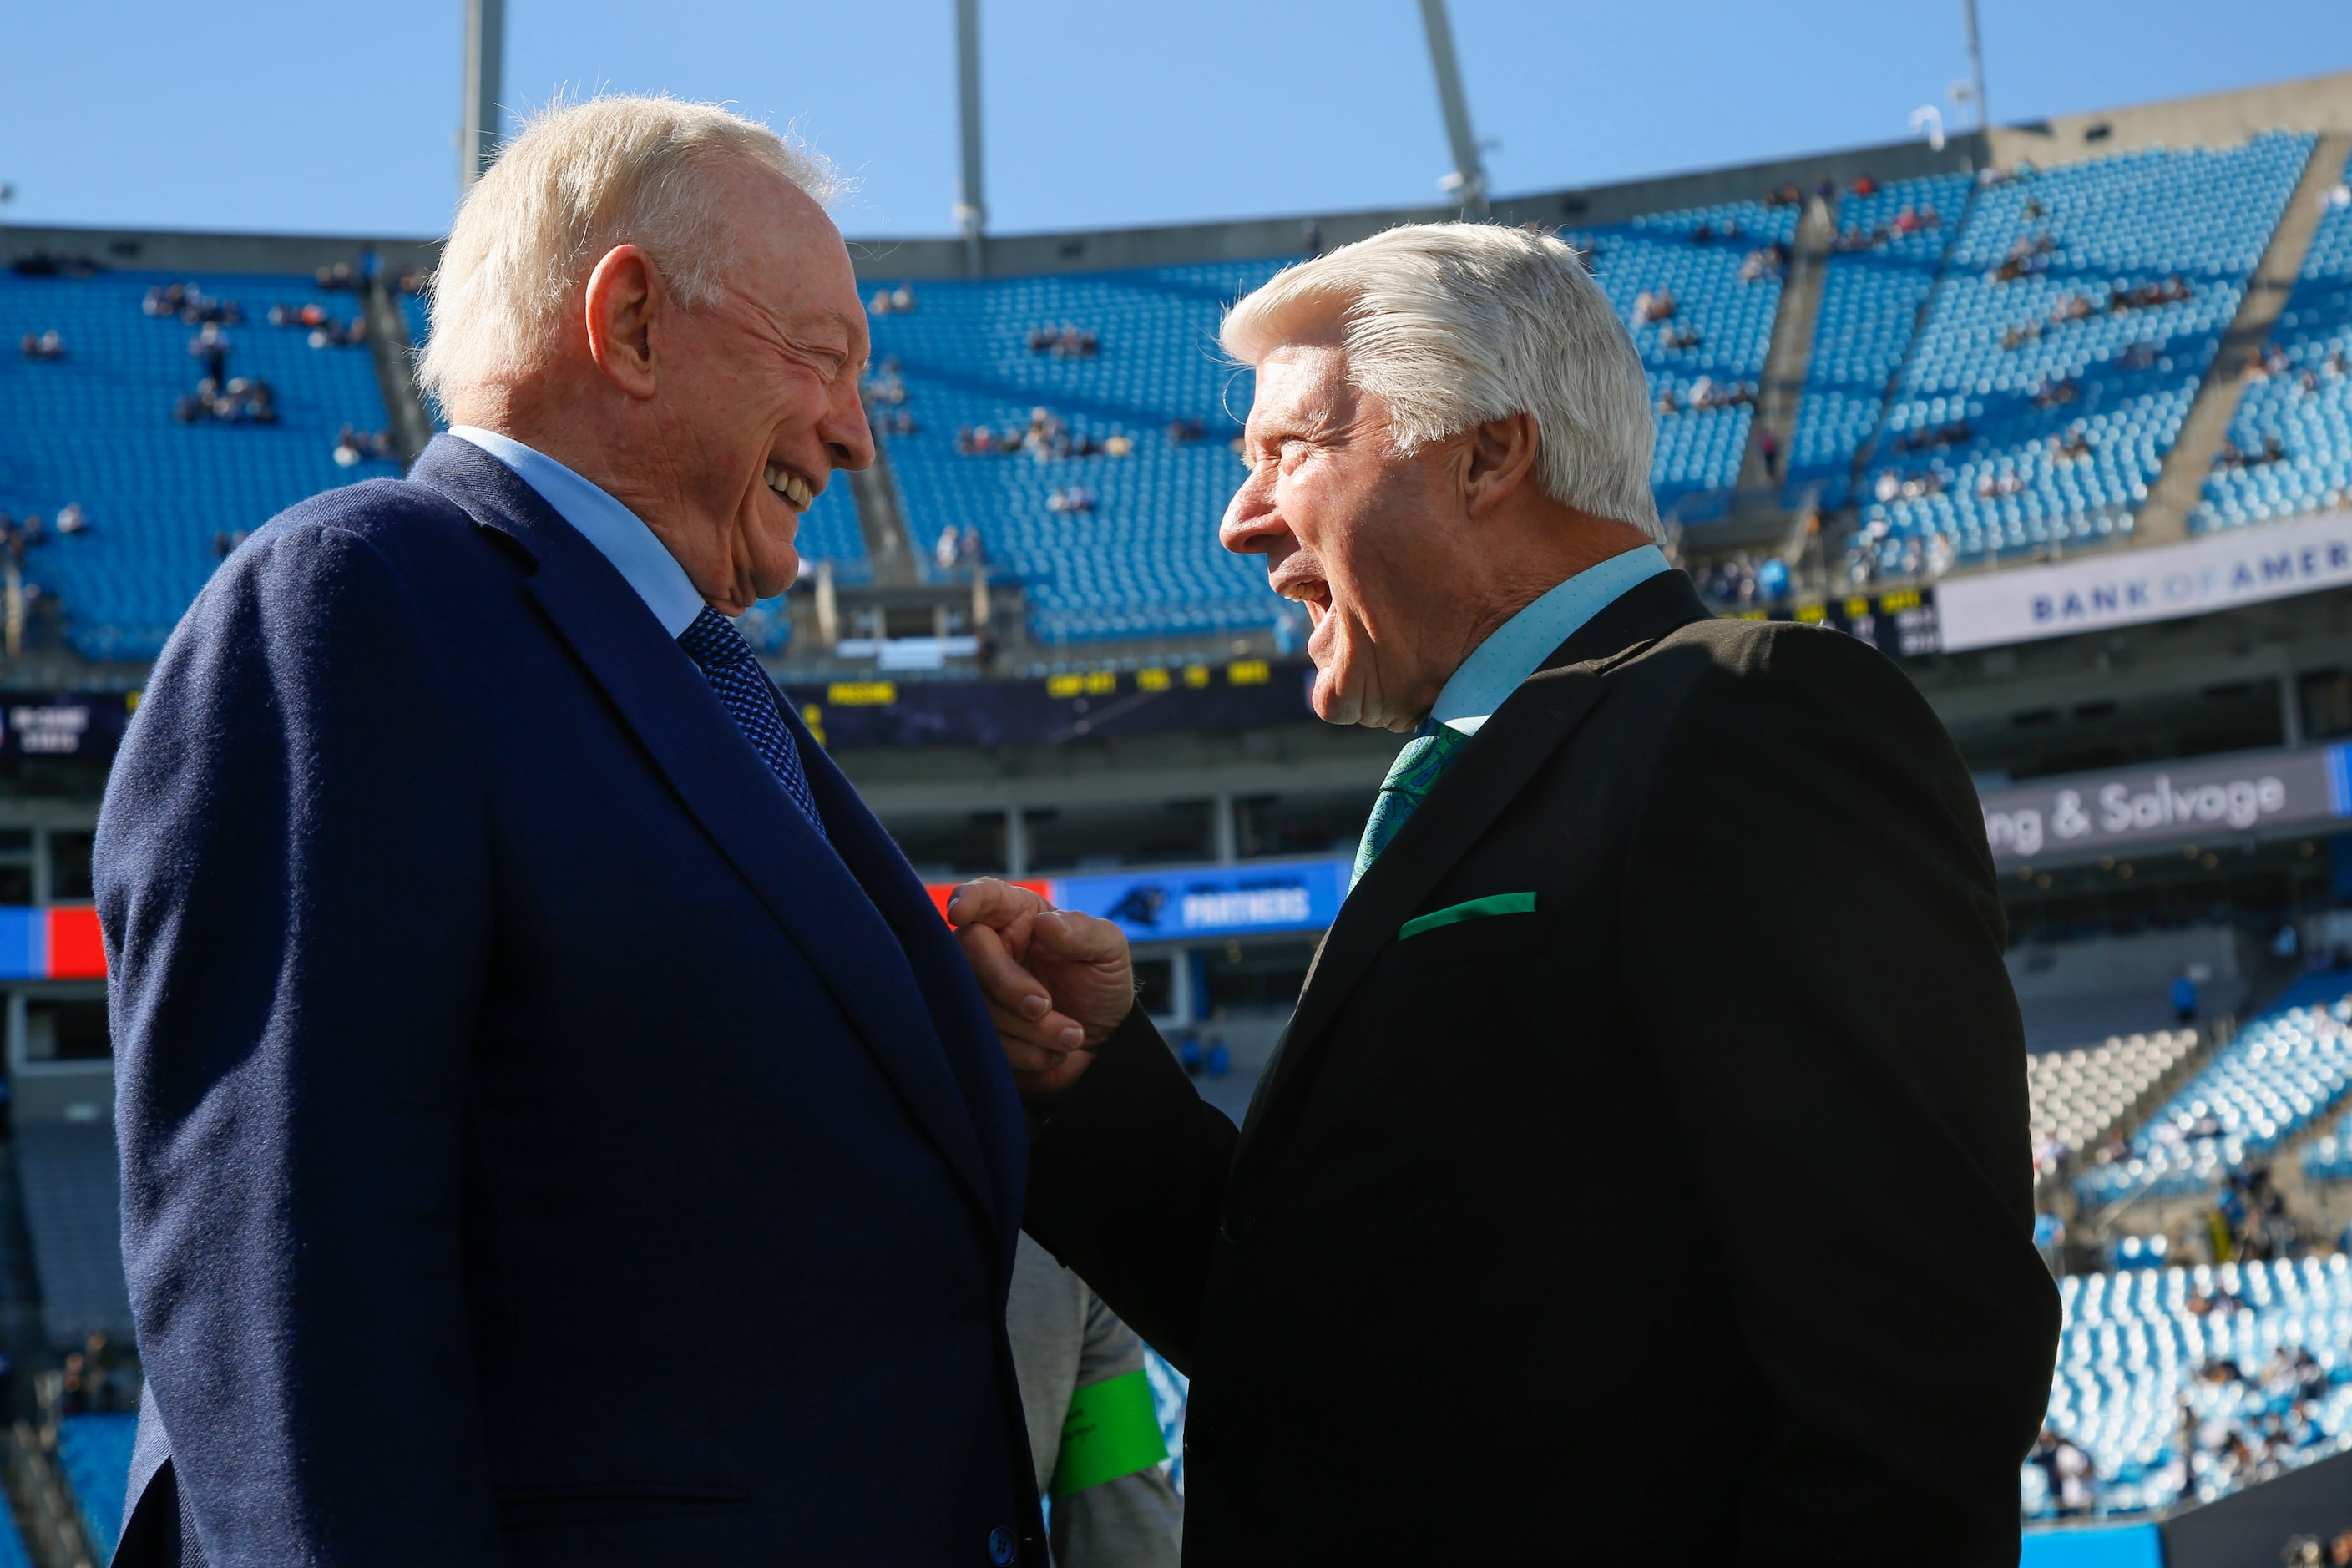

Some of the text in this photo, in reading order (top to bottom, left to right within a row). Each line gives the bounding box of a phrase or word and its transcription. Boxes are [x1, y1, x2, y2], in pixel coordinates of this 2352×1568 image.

[2031, 542, 2350, 622] BANK OF AMER
[2052, 788, 2090, 839] &
[2099, 773, 2286, 832] Salvage
